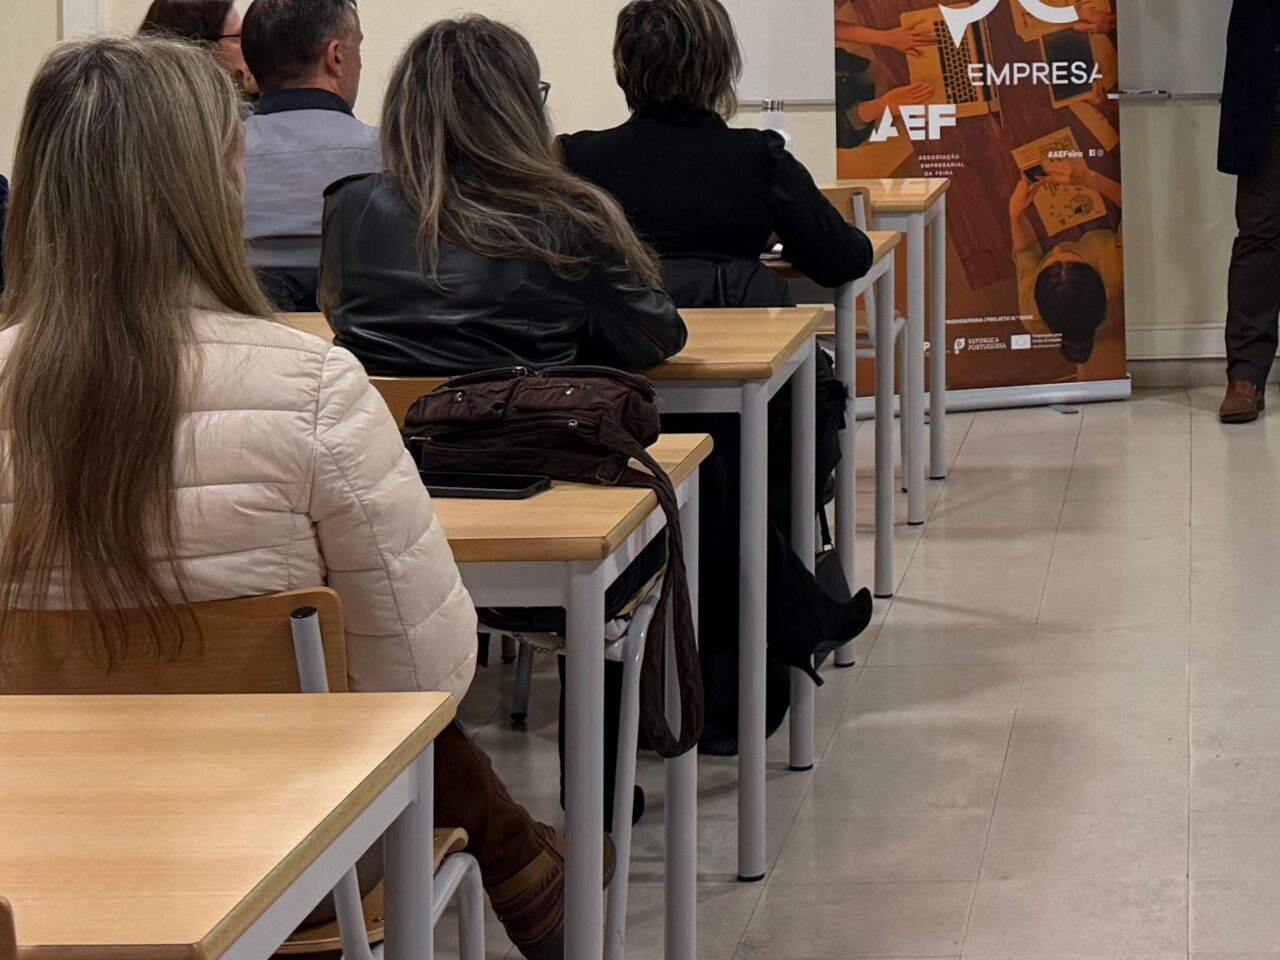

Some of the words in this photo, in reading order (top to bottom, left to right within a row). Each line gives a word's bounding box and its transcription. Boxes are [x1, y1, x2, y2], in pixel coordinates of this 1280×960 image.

[967, 61, 1104, 87] EMPRESA
[869, 103, 957, 143] AEF
[917, 152, 961, 161] ASSOCIAÇÃO
[1046, 150, 1084, 159] #AEFeira
[919, 161, 966, 169] EMPRESARIAL
[934, 169, 954, 177] FEIRA
